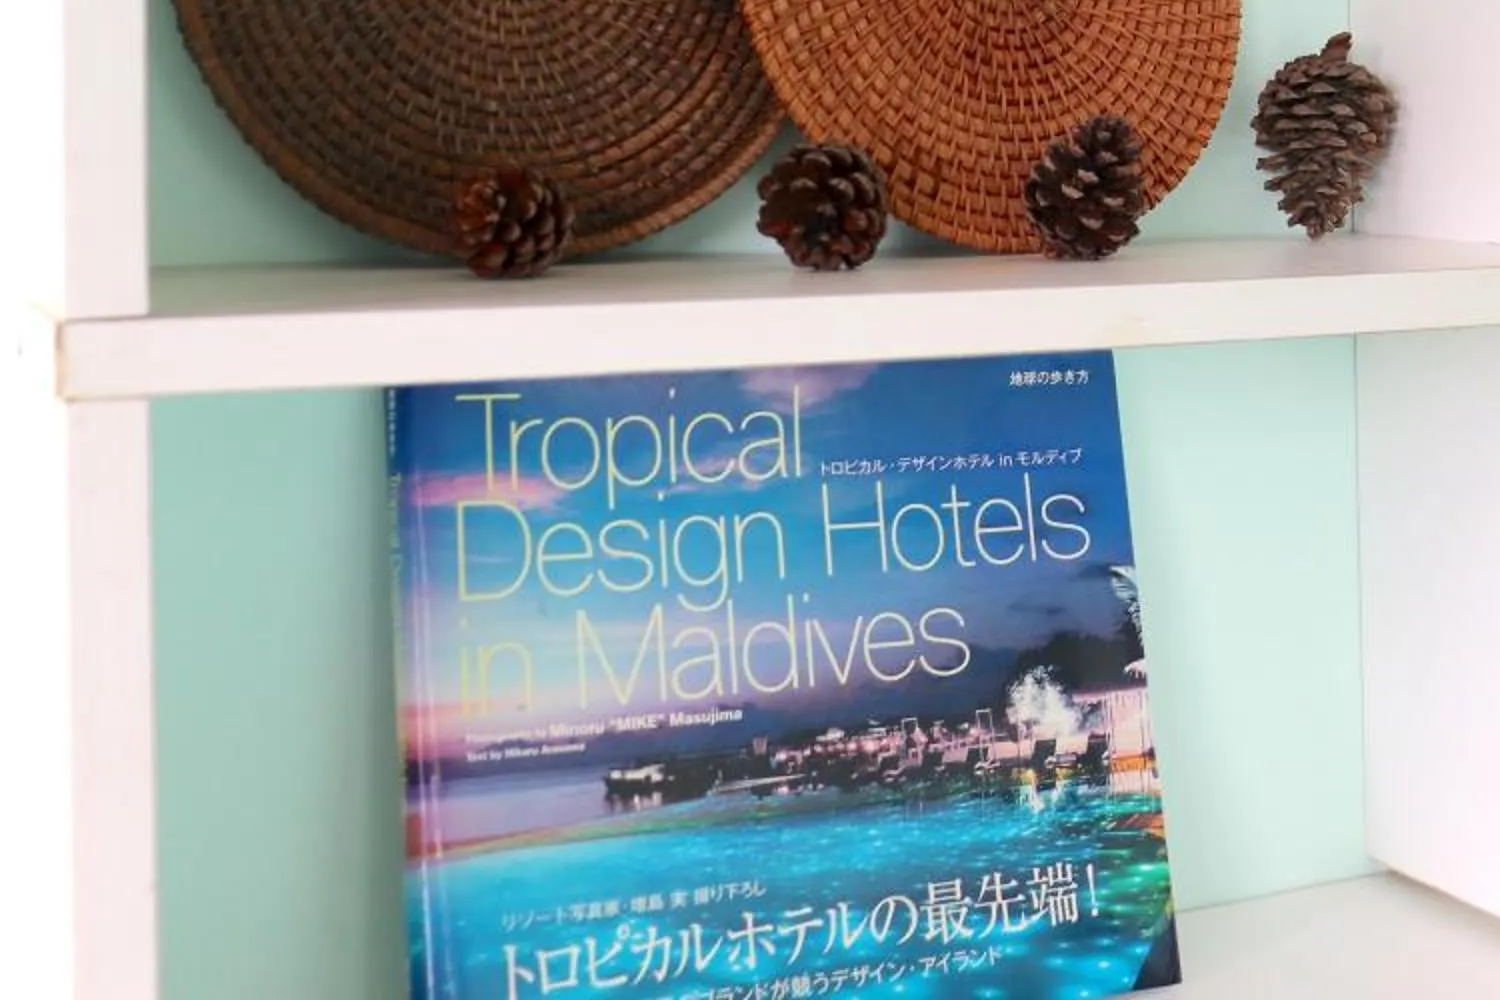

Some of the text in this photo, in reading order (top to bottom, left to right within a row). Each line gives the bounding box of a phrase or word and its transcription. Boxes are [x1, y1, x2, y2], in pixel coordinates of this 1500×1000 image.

[1009, 369, 1090, 387] 地球の歩き方
[455, 385, 803, 509] Tropical
[999, 453, 1014, 468] in
[1015, 447, 1084, 466] モルディブ
[456, 491, 786, 611] Design
[822, 470, 1092, 577] Hotels
[456, 592, 972, 720] in Maldives
[549, 721, 605, 738] Minoru
[669, 707, 744, 728] Masujima
[502, 862, 1100, 1000] トロピカルホテルの最先端！
